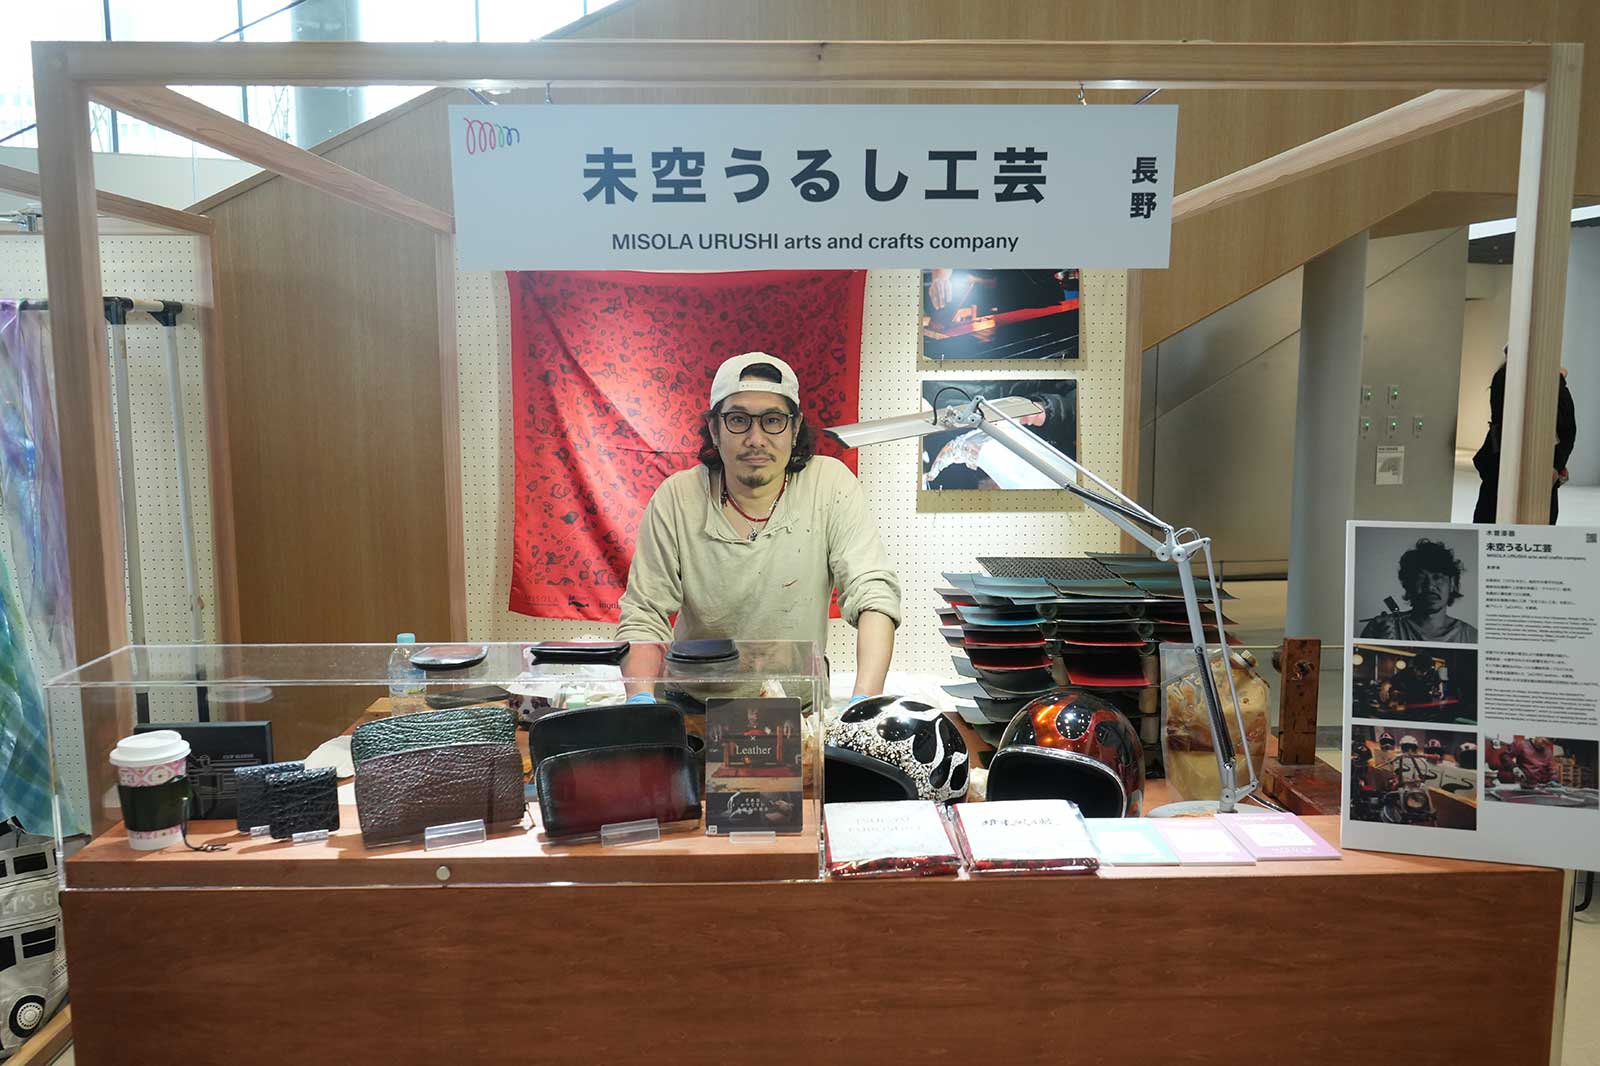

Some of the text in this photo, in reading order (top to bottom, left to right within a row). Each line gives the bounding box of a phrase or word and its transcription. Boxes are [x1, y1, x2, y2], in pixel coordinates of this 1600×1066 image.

[583, 146, 1049, 205] 未空うるし工芸
[1129, 156, 1159, 220] 長野
[612, 232, 1019, 254] MISOLA URUSHI arts and crafts company
[1486, 543, 1552, 552] 未空うるし工芸
[735, 744, 772, 755] Leather
